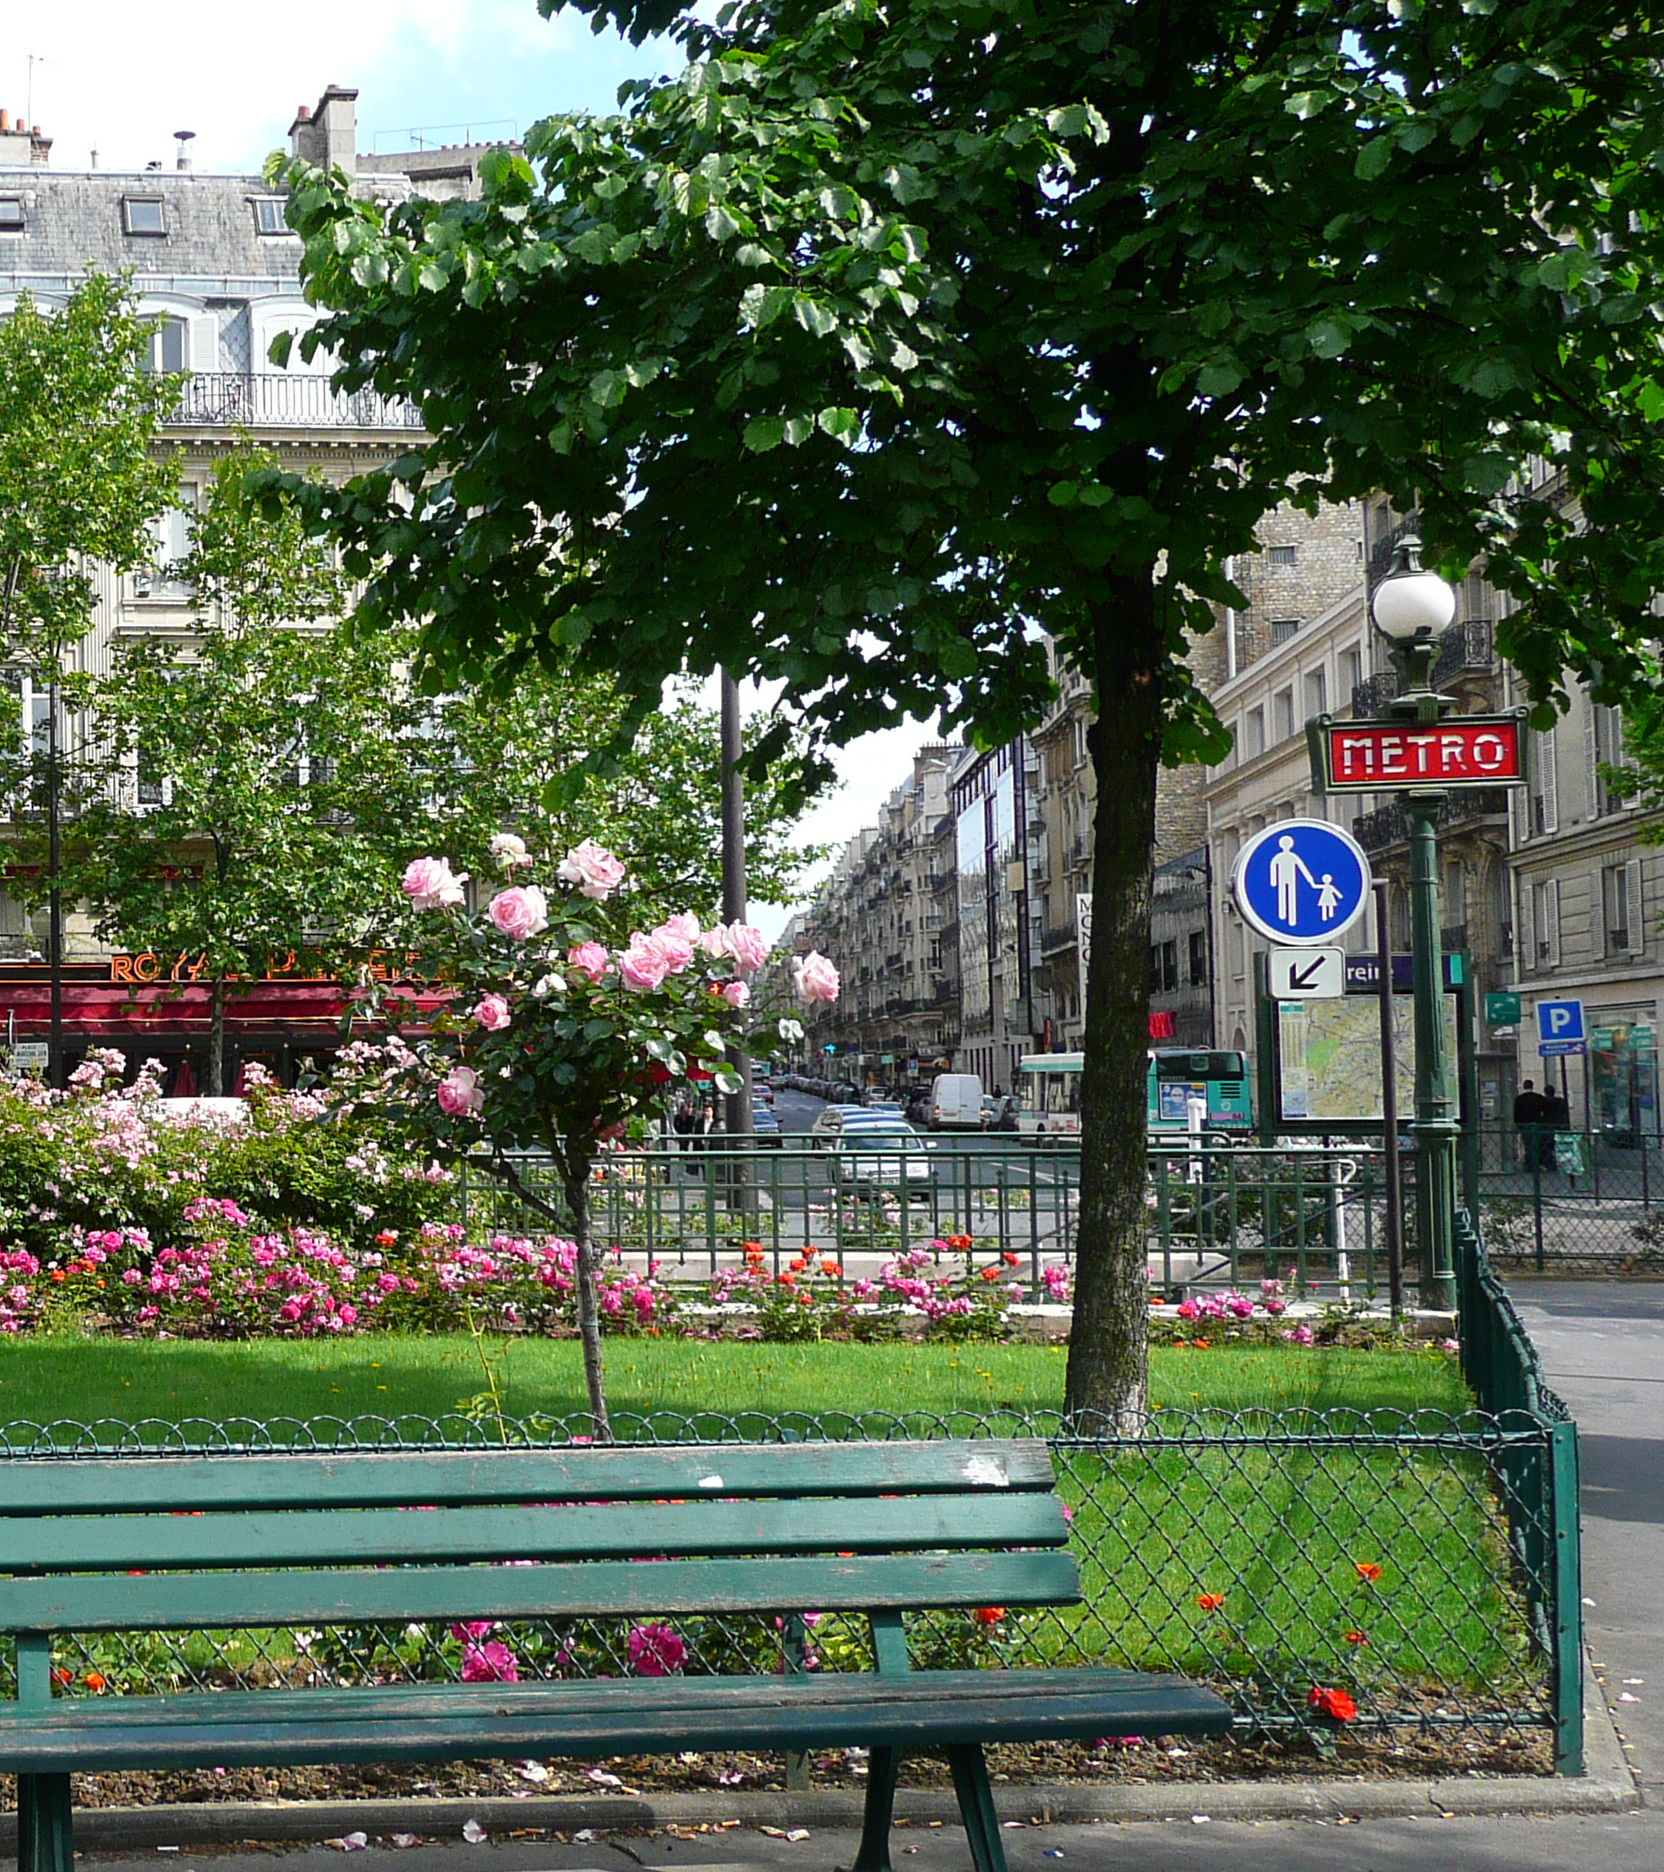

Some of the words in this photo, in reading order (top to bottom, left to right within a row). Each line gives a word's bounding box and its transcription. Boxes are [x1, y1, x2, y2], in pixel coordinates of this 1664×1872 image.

[1343, 733, 1505, 775] METRO
[111, 951, 250, 981] ROYA
[1549, 1008, 1571, 1034] P
